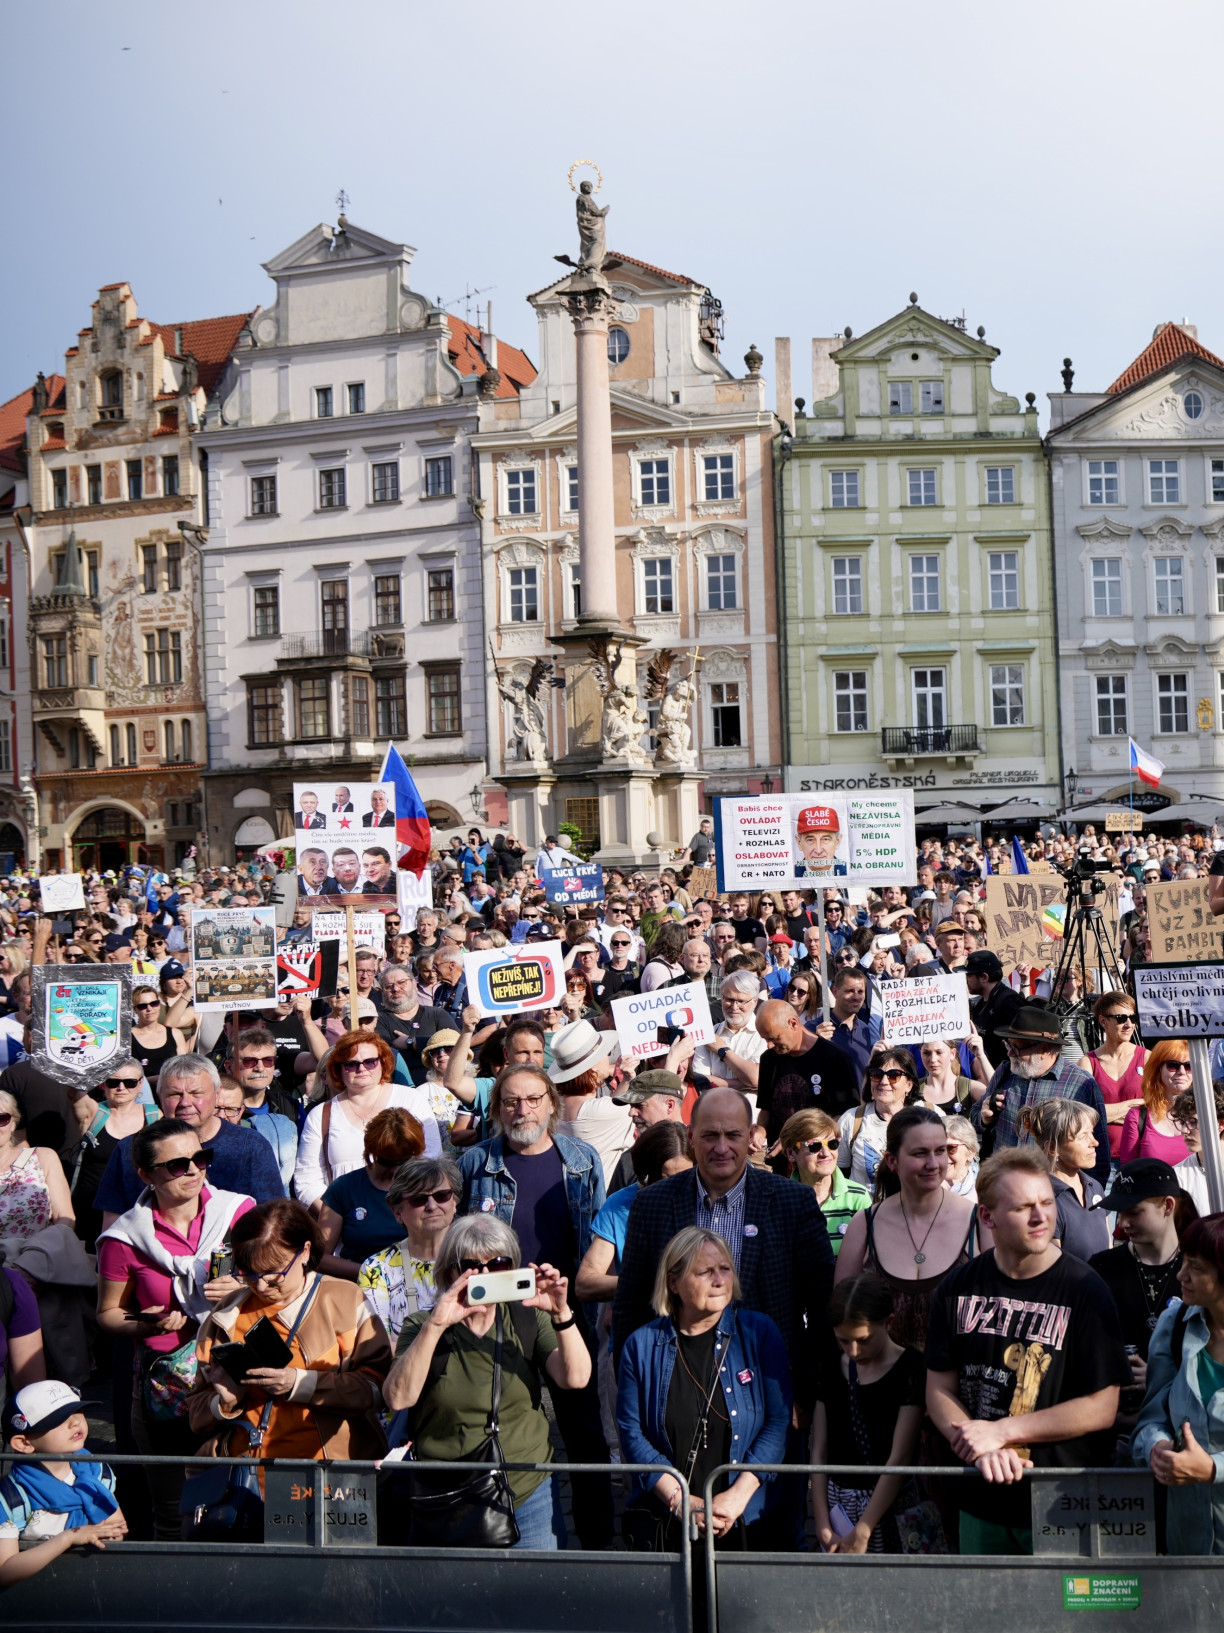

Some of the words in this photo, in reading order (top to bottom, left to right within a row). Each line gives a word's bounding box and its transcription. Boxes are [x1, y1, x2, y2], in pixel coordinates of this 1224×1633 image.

[800, 769, 936, 791] STAROMĚSTSKÁ
[988, 776, 1039, 784] RESTAURANT
[764, 804, 782, 812] chce
[805, 808, 830, 818] SLABÉ
[740, 816, 782, 825] OVLÁDAT
[850, 812, 900, 820] NEZÁVISLÁ
[806, 818, 830, 826] ČESKO
[742, 828, 780, 836] TELEVIZI
[861, 831, 890, 840] MÉDIA
[735, 851, 790, 860] OSLABOVAT
[875, 848, 898, 856] HDP
[552, 868, 574, 878] RUCE
[576, 864, 598, 876] PRYČ
[850, 862, 863, 870] NA
[741, 870, 753, 878] ČR
[554, 892, 570, 902] OD
[573, 886, 598, 900] MÉDIÍ
[492, 967, 524, 985] NEŽIVÍŠ,
[524, 966, 540, 980] TAK
[1140, 970, 1193, 982] závislými
[881, 979, 908, 990] RADŠI
[56, 986, 72, 998] ČT
[493, 983, 542, 1000] NEPŘEPÍNEJ!
[1142, 986, 1178, 1001] chtějí
[628, 988, 692, 1014] OVLADAČ
[885, 1001, 890, 1010] S
[895, 994, 956, 1008] ROZHLEDEM
[638, 1020, 658, 1033] OD
[886, 1028, 894, 1040] S
[898, 1021, 963, 1037] CENZUROU
[1092, 1578, 1138, 1586] DOPRAVNÍ
